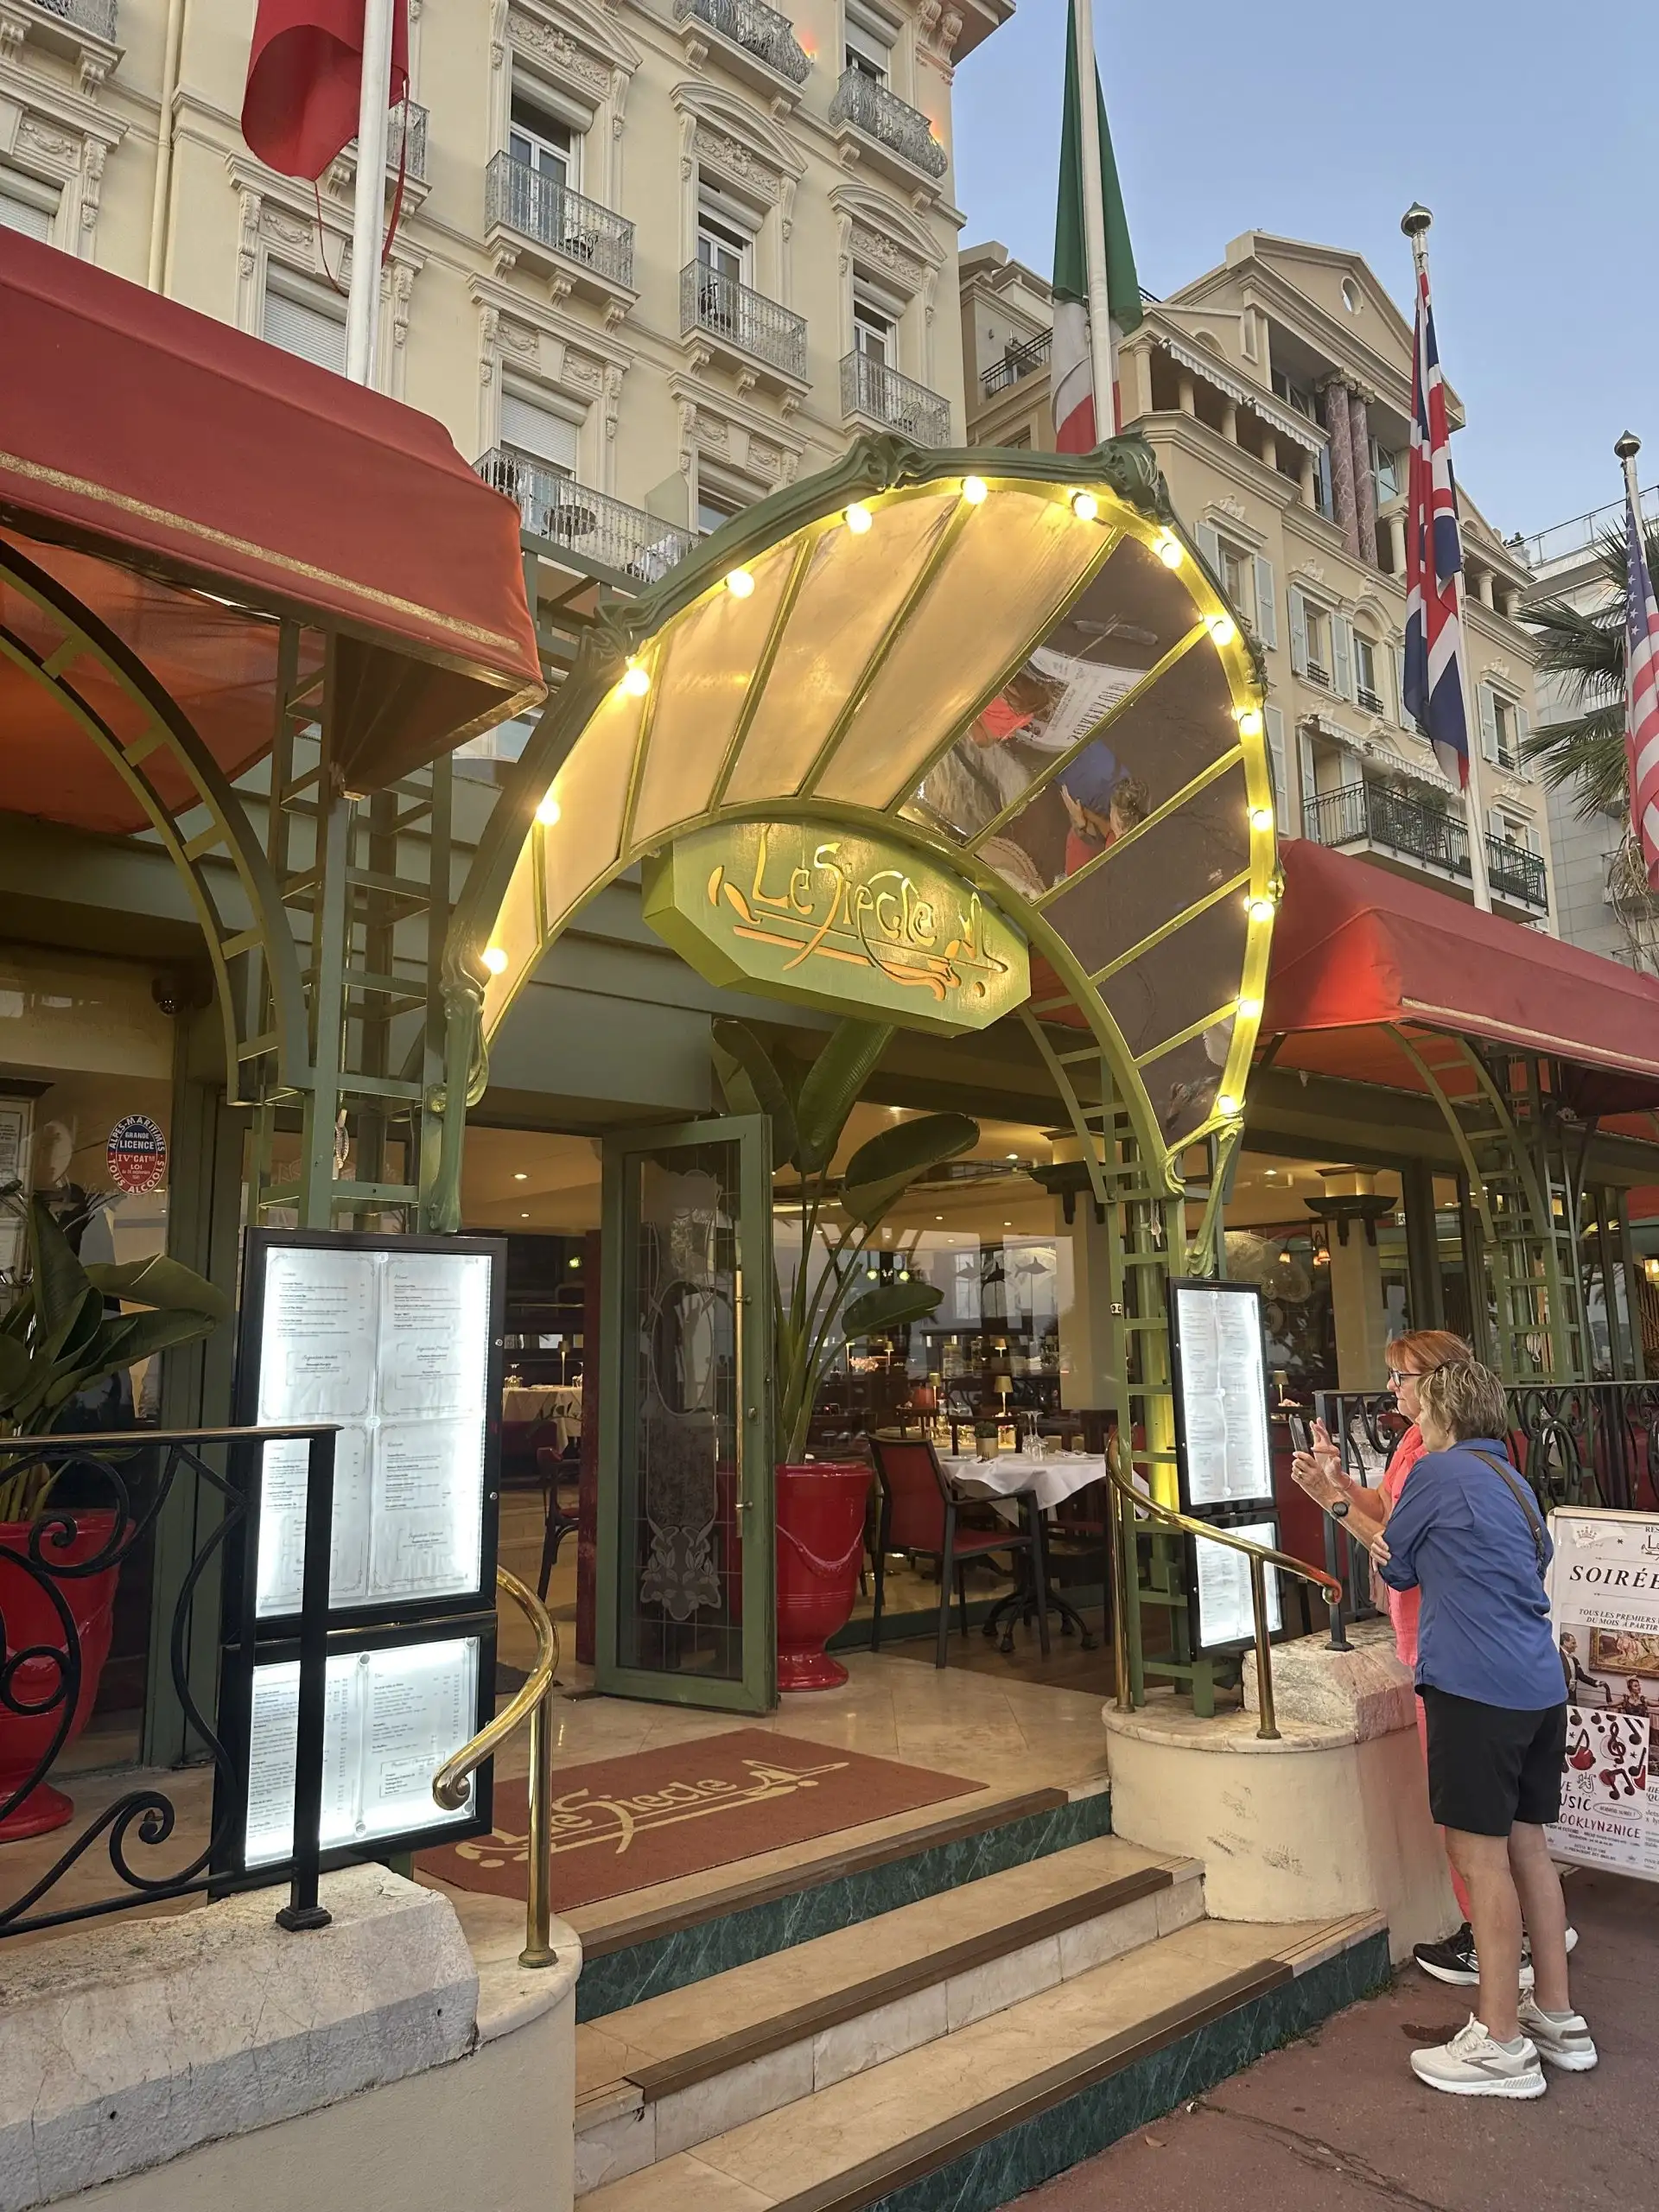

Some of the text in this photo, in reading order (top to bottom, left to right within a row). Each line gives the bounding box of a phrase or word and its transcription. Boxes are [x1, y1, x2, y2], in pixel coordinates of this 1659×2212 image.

[752, 823, 815, 916] Le
[108, 1116, 165, 1152] ALPES-MARITIMES
[124, 1131, 149, 1140] GRANDE
[119, 1140, 155, 1150] LICENCE
[108, 1158, 165, 1193] TOUS ALCOOLS
[1579, 1608, 1599, 1617] TOUS
[1616, 1612, 1656, 1624] PREMIERS
[1599, 1618, 1620, 1626] MOIS
[1628, 1621, 1658, 1631] PARTIR
[1560, 1794, 1592, 1811] USIC
[1560, 1813, 1642, 1839] OOKLYN2NICE
